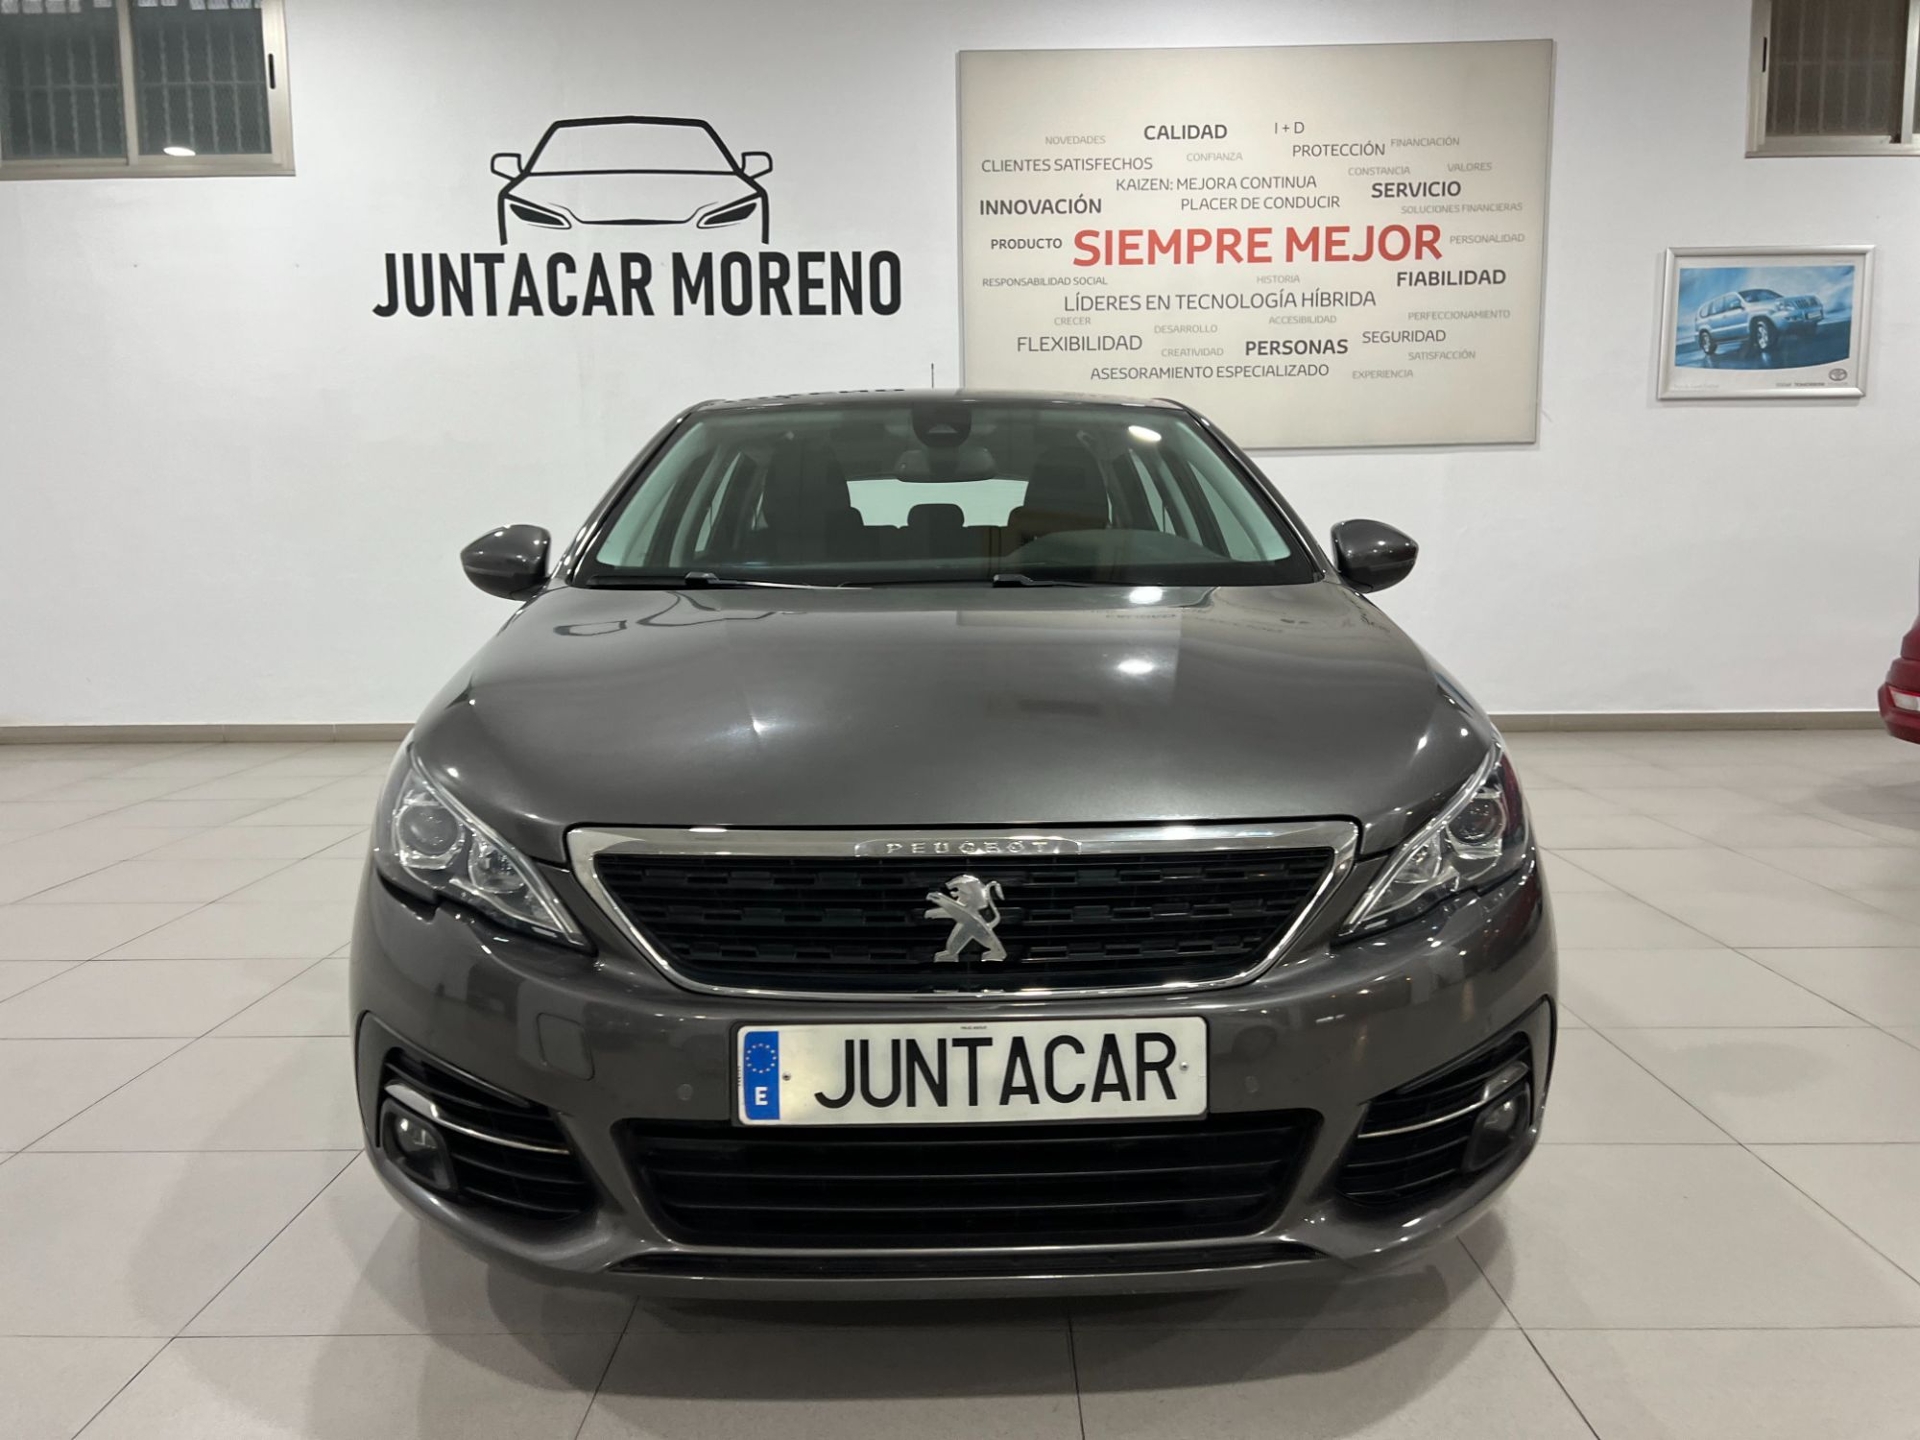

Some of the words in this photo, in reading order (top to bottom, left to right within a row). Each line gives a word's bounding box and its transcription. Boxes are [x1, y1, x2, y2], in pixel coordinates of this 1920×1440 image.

[1144, 125, 1227, 140] CALIDAD
[1045, 136, 1106, 145] NOVEDADES
[1391, 135, 1460, 146] FINANCIACIÓN
[1293, 140, 1385, 157] PROTECCIÓN
[1187, 152, 1243, 161] CONFIANZA
[982, 159, 1051, 172] CLIENTES
[1054, 158, 1152, 171] SATISFECHOS
[1348, 166, 1411, 176] CONSTANCIA
[1448, 162, 1492, 172] VALORES
[1116, 178, 1173, 191] KAIZEN:
[1177, 177, 1237, 190] MEJORA
[1240, 175, 1317, 189] CONTINUA
[1372, 181, 1461, 198] SERVICIO
[980, 194, 1101, 215] INNOVACIÓN
[1182, 198, 1237, 210] PLACER
[1241, 197, 1260, 209] DE
[1264, 196, 1340, 209] CONDUCIR
[1402, 204, 1460, 214] SOLUCIONES
[1462, 202, 1523, 212] FINANCIERAS
[991, 238, 1062, 249] PRODUCTO
[1073, 228, 1272, 266] SIEMPRE
[1286, 224, 1442, 262] MEJOR
[1450, 233, 1525, 244] PERSONALIDAD
[372, 252, 654, 317] JUNTACAR
[672, 251, 901, 316] MORENO
[983, 277, 1071, 287] RESPONSABILIDAD
[1073, 277, 1108, 285] SOCIAL
[1257, 275, 1300, 284] HISTORIA
[1397, 270, 1506, 286] FIABILIDAD
[1065, 292, 1141, 311] LÍDERES
[1146, 295, 1170, 310] EN
[1175, 289, 1297, 309] TECNOLOGÍA
[1302, 288, 1376, 307] HÍBRIDA
[1269, 315, 1337, 324] ACCESIBILIDAD
[1408, 309, 1511, 320] PERFECCIONAMIENTO
[1054, 317, 1091, 326] CRECER
[1154, 325, 1218, 334] DESARROLLO
[1018, 335, 1142, 351] FLEXIBILIDAD
[1363, 330, 1446, 343] SEGURIDAD
[1161, 348, 1224, 357] CREATIVIDAD
[1246, 339, 1348, 355] PERSONAS
[1408, 349, 1476, 360] SATISFACCIÓN
[1091, 366, 1213, 380] ASESORAMIENTO
[1217, 364, 1329, 378] ESPECIALIZADO
[1352, 370, 1413, 379] EXPERIENCIA
[886, 840, 1048, 854] PEUGEOT
[814, 1032, 1177, 1108] JUNTACAR
[755, 1087, 768, 1105] E
